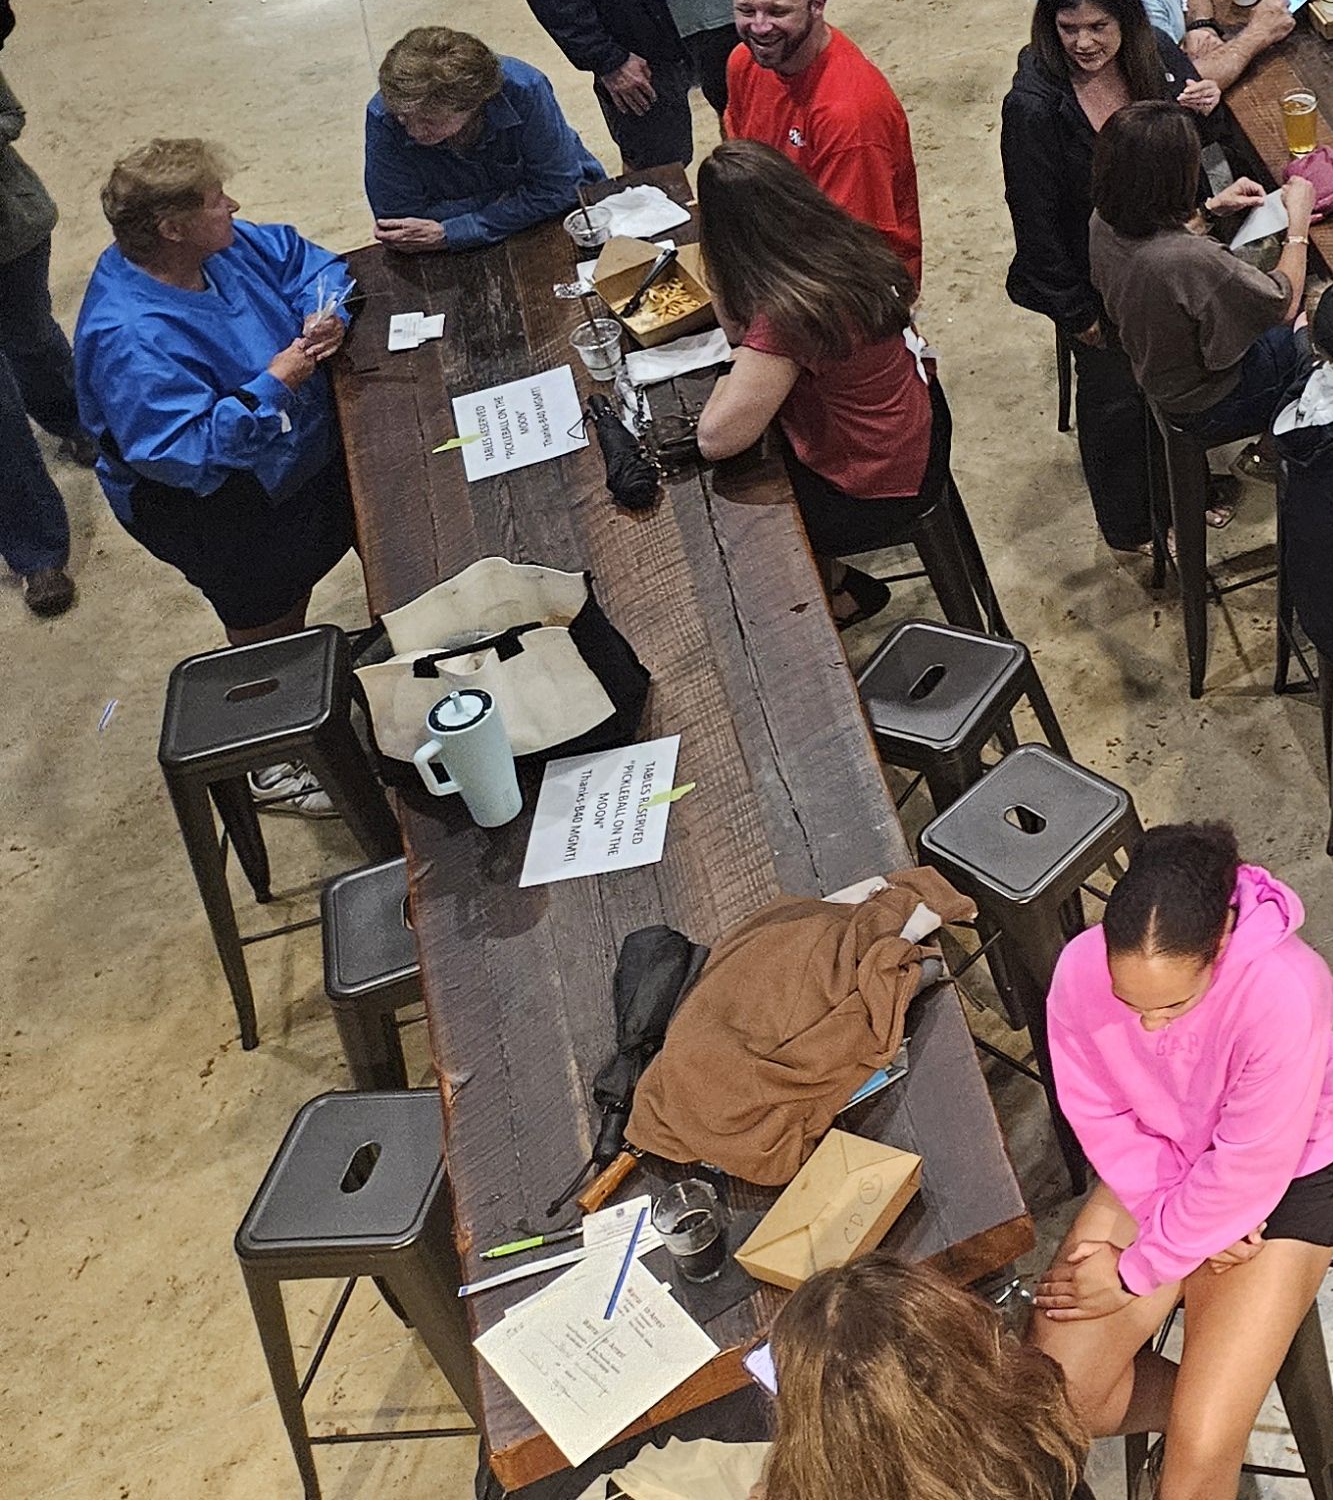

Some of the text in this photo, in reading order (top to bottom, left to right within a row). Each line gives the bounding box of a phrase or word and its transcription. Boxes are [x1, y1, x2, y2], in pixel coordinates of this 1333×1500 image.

[475, 405, 496, 461] TABLES RESERVED
[493, 395, 517, 460] "PICKLEBALL ON THE
[514, 410, 529, 435] MOON"
[571, 769, 593, 827] Thanks-B40
[593, 792, 609, 829] MOON"
[607, 759, 636, 857] "PICKLEBALL ON THE
[632, 760, 656, 845] TABLES RESERVED
